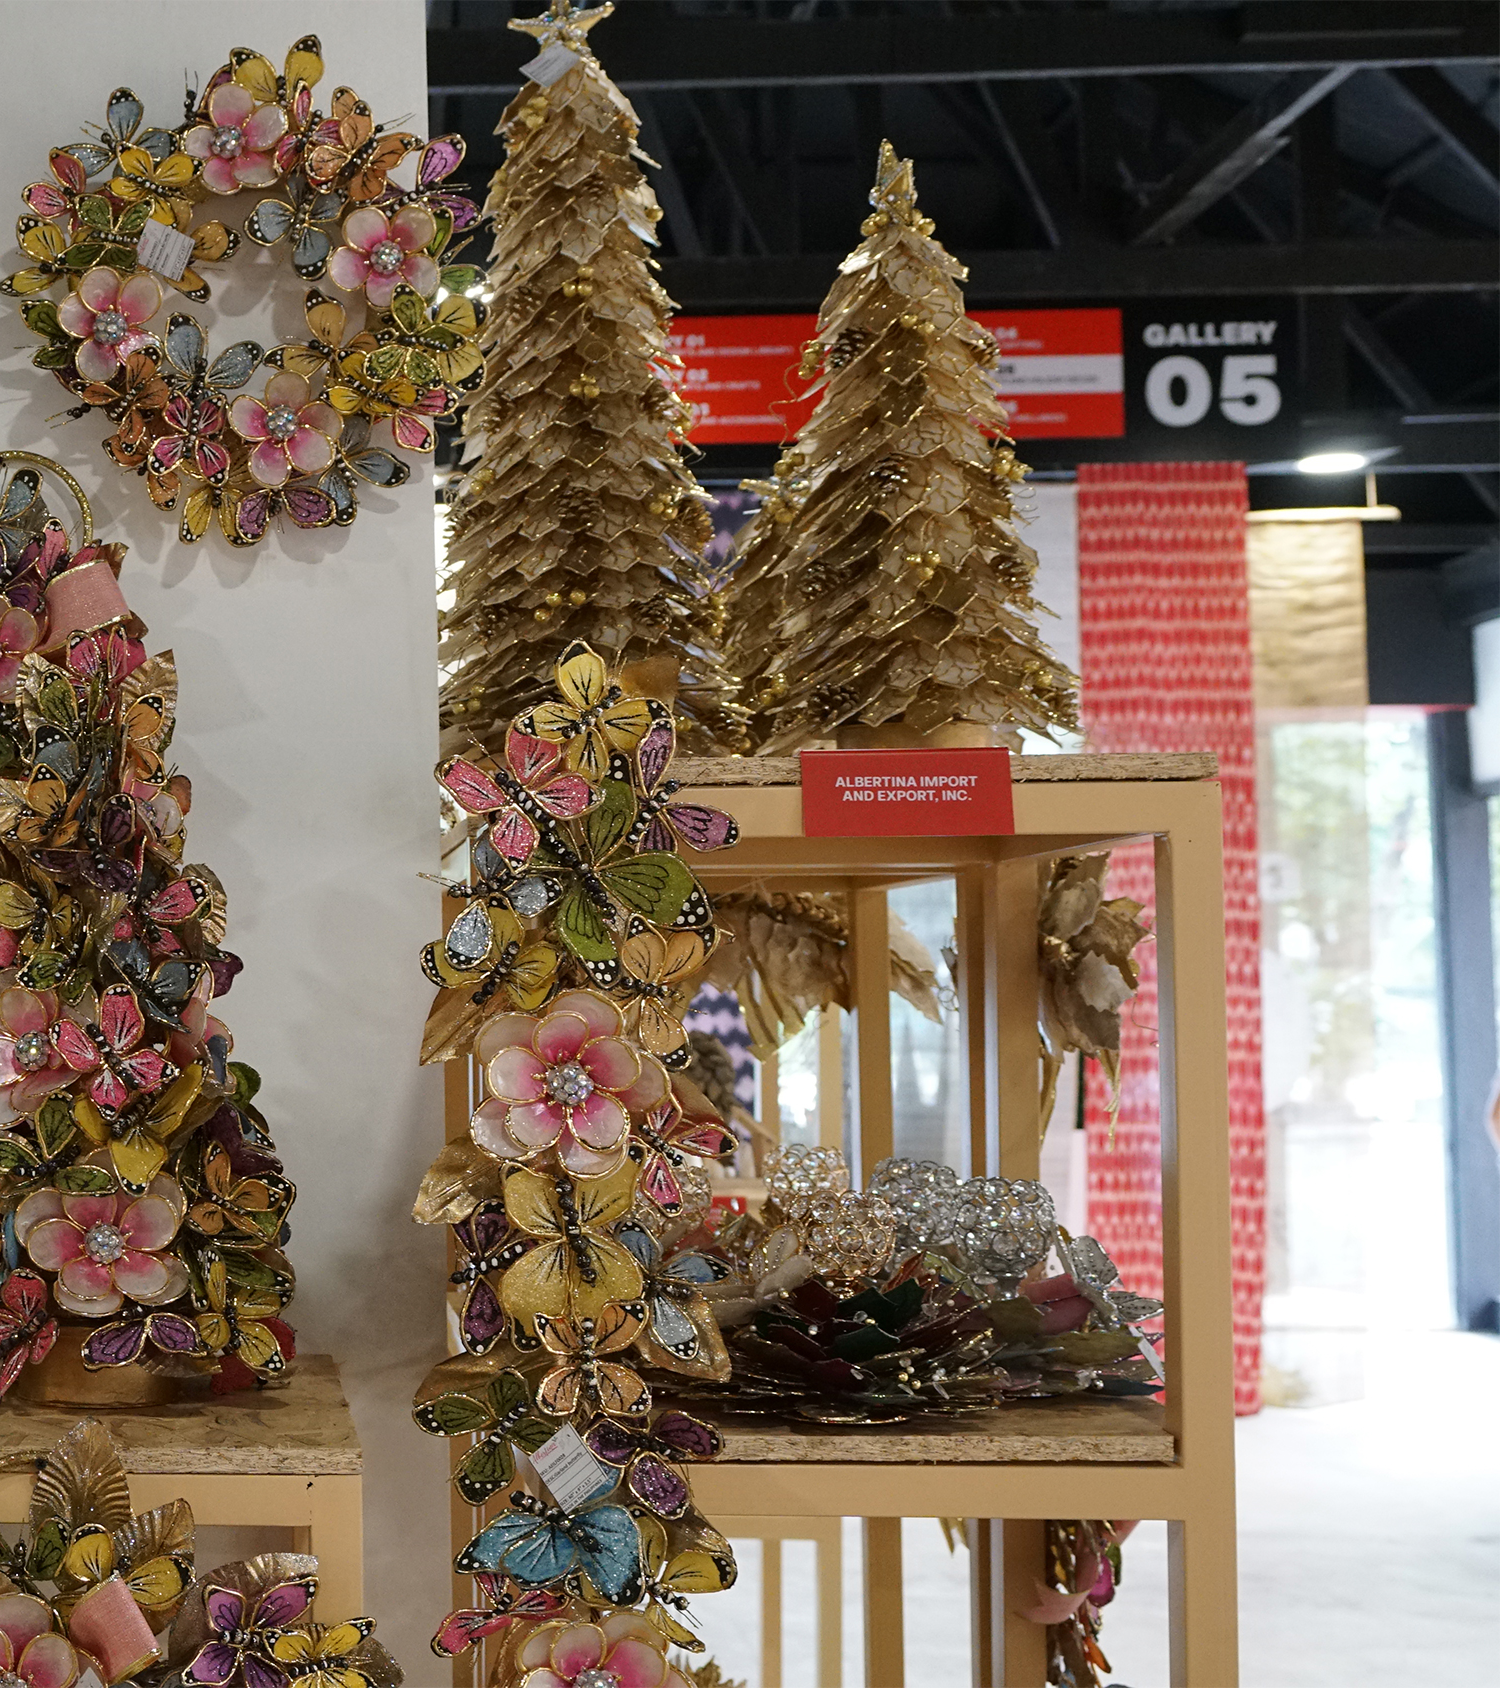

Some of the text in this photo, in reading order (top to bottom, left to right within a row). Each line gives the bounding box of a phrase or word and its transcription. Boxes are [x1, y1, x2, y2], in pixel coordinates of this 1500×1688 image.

[1142, 320, 1278, 348] GALLERY
[1144, 353, 1283, 429] 05
[835, 775, 978, 788] ALBERTINA IMPORT
[842, 789, 973, 803] AND EXPORT, INC.
